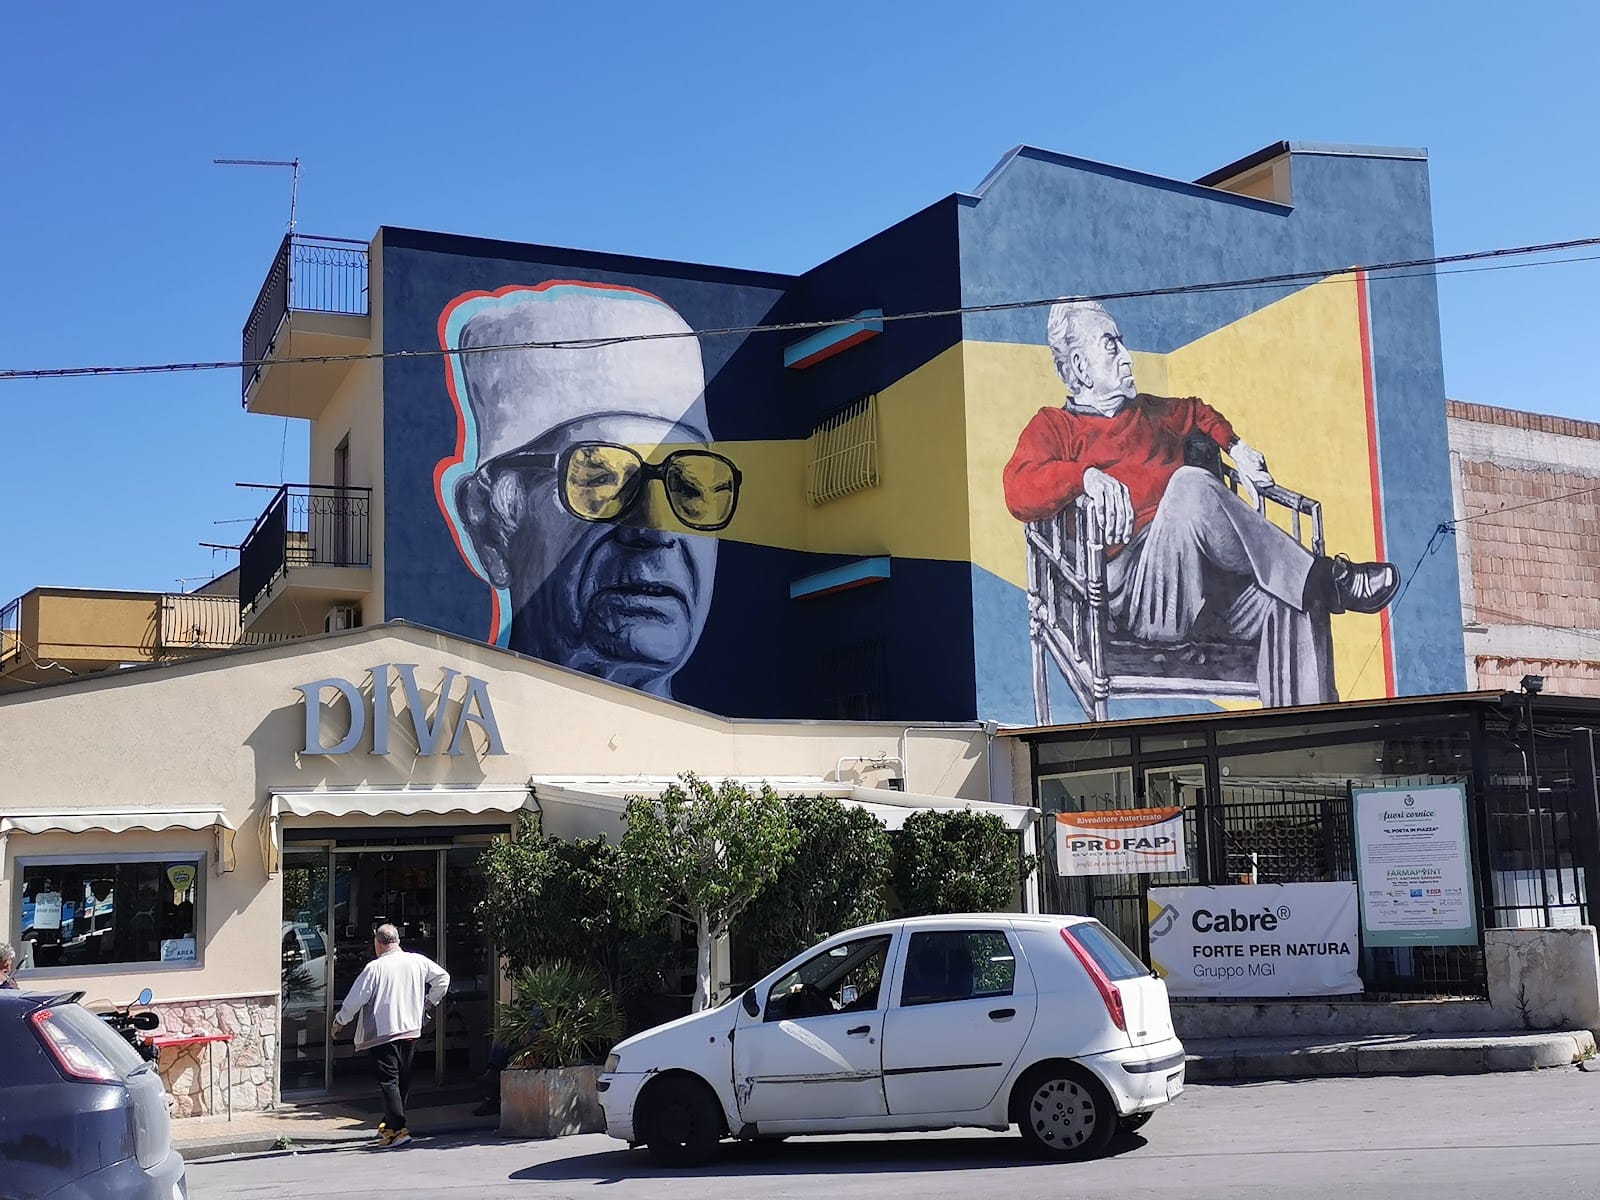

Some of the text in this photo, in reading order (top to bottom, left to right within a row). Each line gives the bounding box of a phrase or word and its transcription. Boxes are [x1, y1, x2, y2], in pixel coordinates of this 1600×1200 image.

[292, 663, 509, 756] DIVA
[1077, 814, 1162, 824] Rivenditore Autorizzato
[1383, 811, 1404, 821] fuori
[1406, 810, 1434, 818] cornice
[1071, 836, 1170, 852] PROFAP
[1193, 942, 1350, 958] FORTE PER NATURA
[1193, 963, 1275, 980] Gruppo MGI
